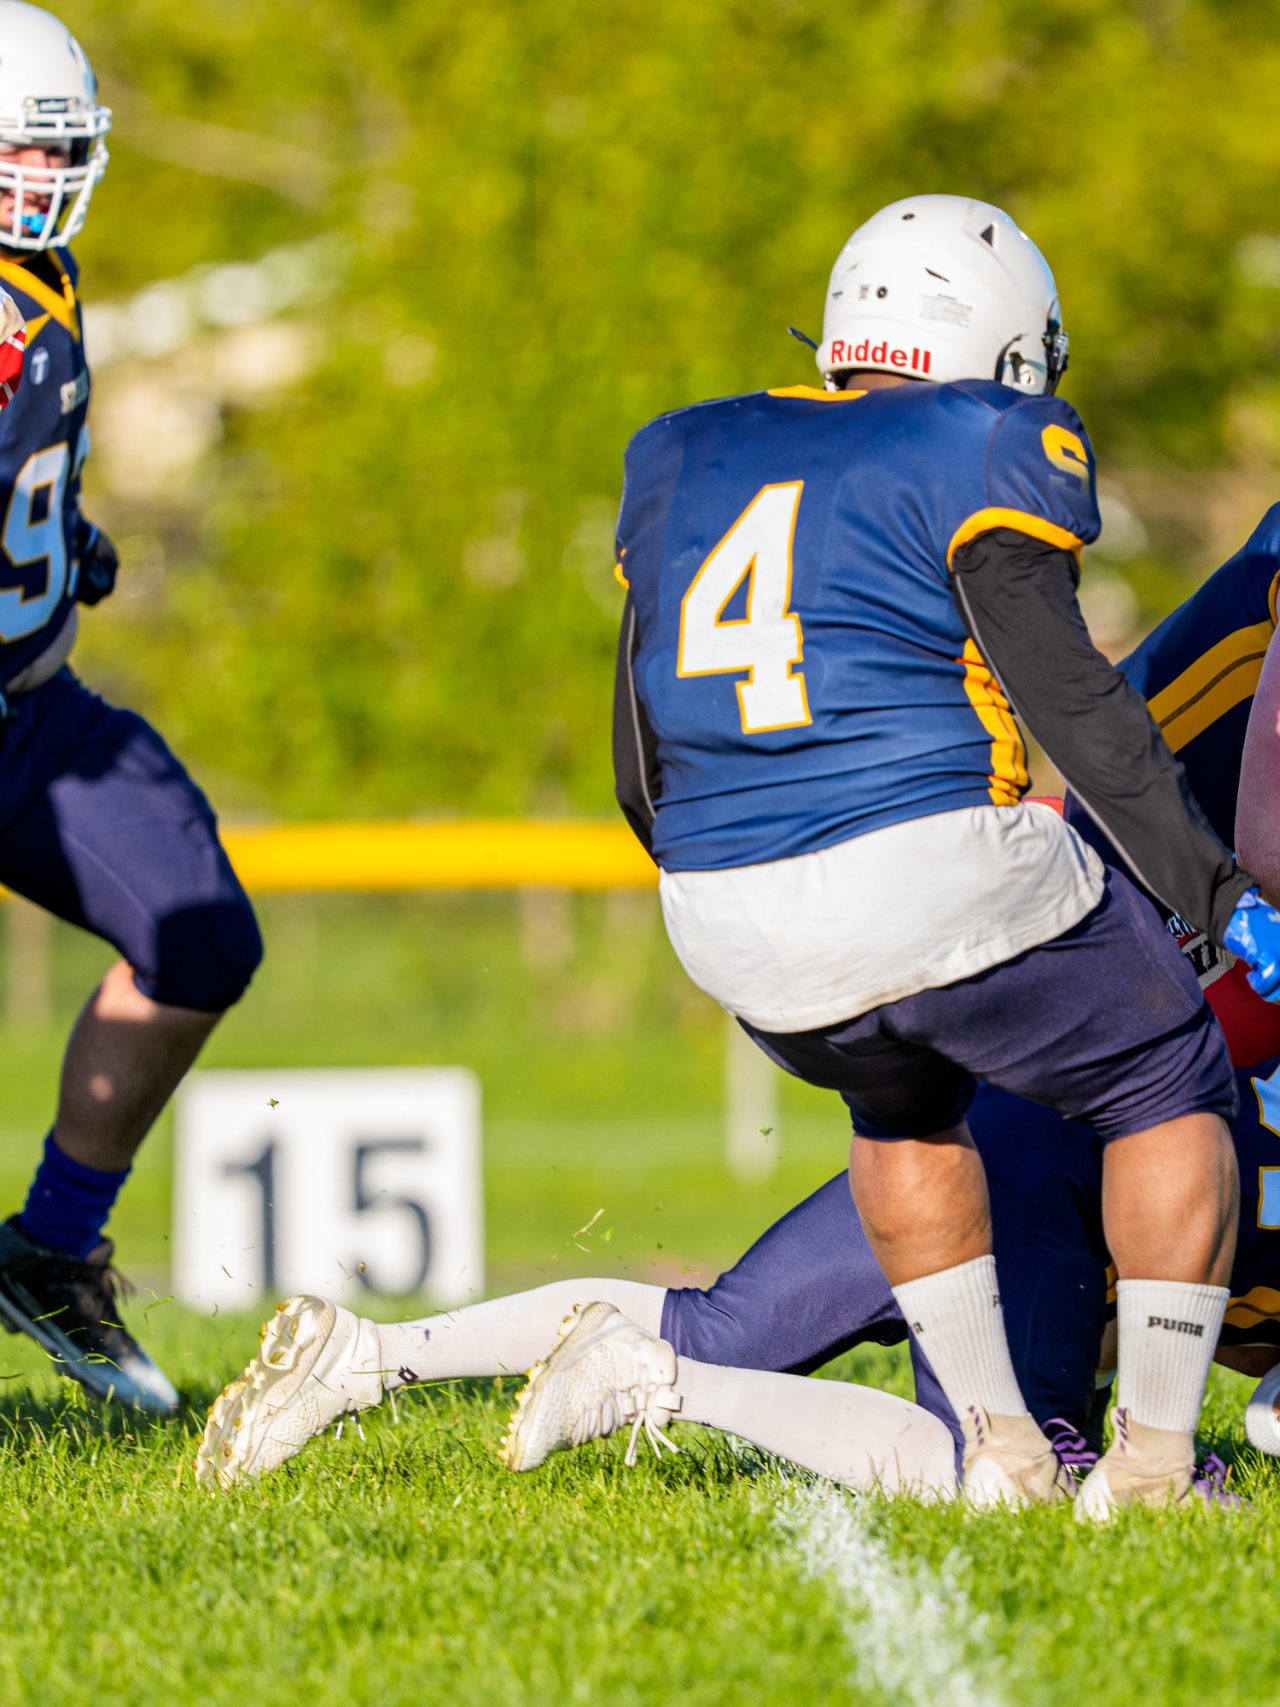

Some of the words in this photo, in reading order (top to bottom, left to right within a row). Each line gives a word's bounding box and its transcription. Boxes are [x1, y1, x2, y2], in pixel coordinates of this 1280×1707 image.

[831, 339, 932, 374] Riddell
[0, 424, 88, 644] 9
[676, 479, 813, 735] 4
[222, 1136, 434, 1297] 15
[1146, 1315, 1205, 1338] PUMA
